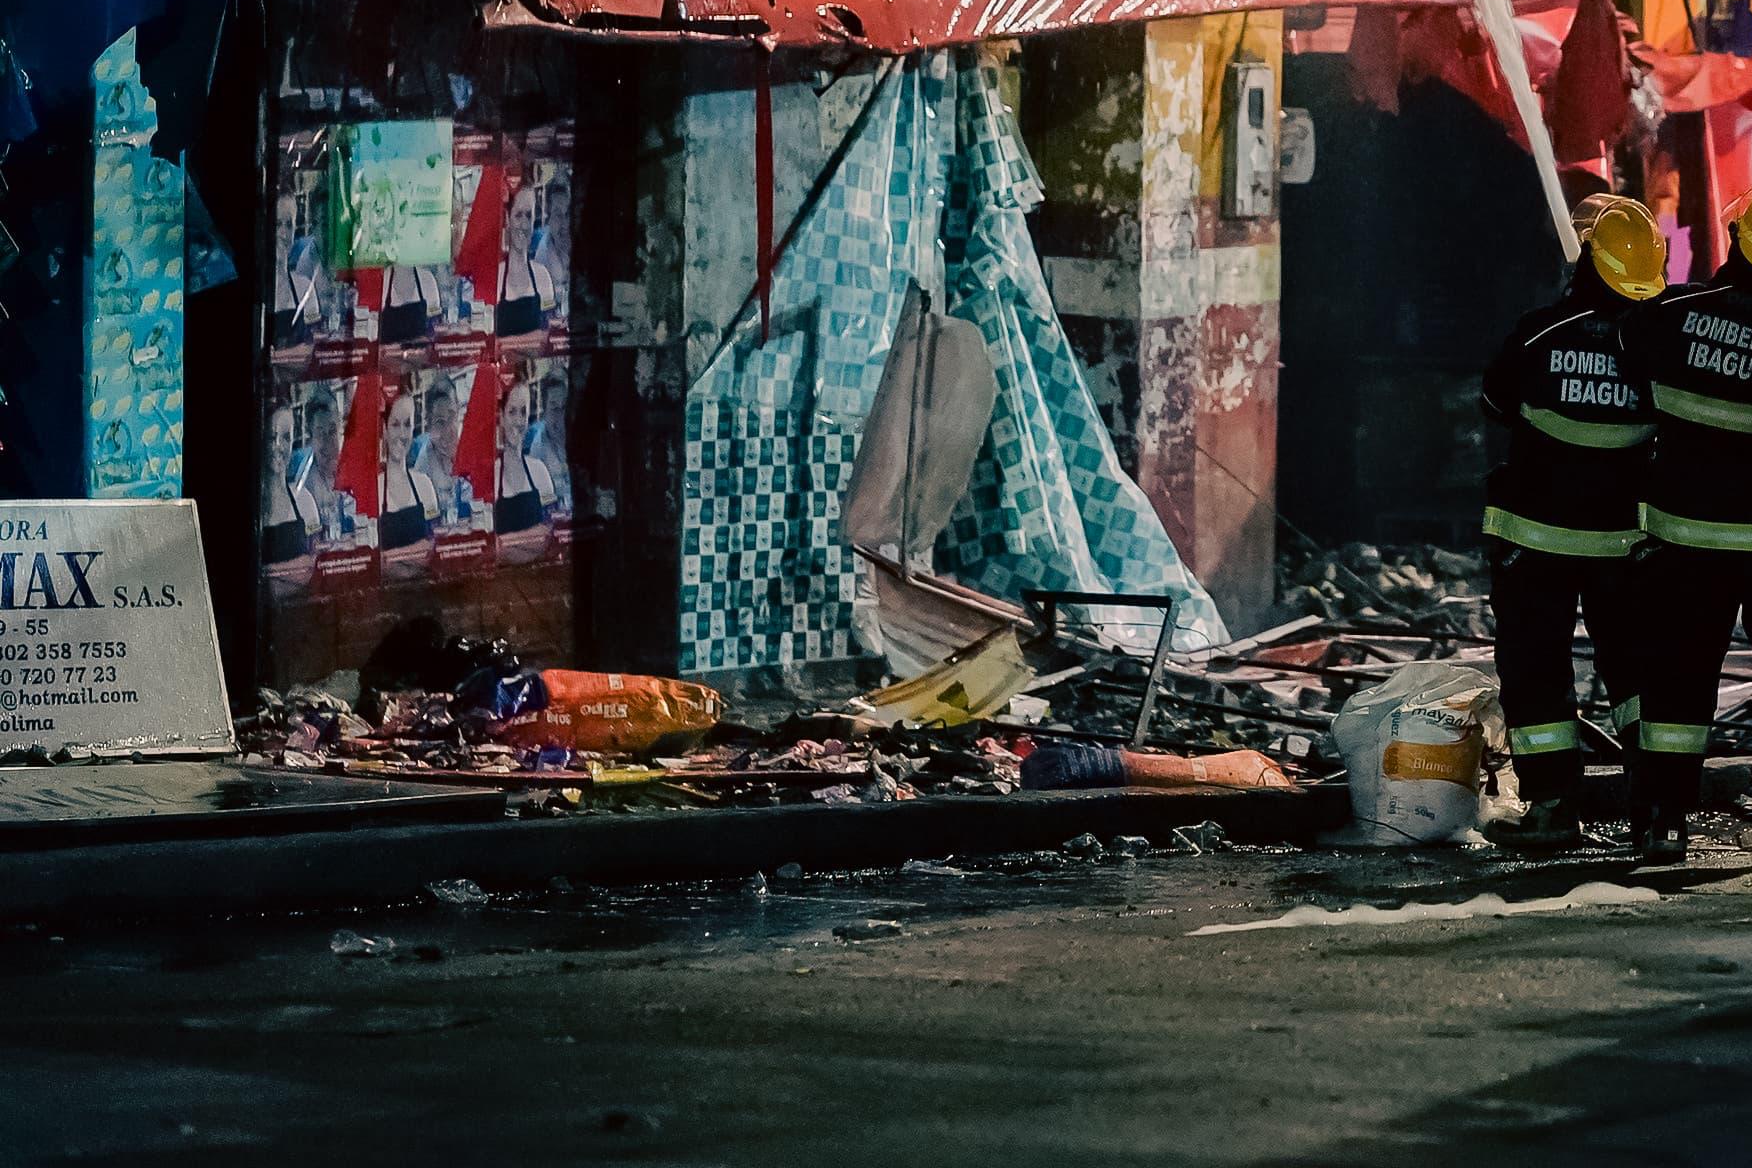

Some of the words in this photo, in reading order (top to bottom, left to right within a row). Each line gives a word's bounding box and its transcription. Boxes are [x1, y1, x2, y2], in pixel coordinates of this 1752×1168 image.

[113, 584, 183, 609] S.A.S.
[25, 618, 49, 636] 55
[35, 642, 72, 660] 358
[79, 641, 127, 659] 7553
[20, 668, 56, 685] 720
[63, 666, 87, 684] 77
[93, 665, 117, 683] 23
[1, 687, 140, 711] @hotmail.com
[0, 715, 56, 732] olima
